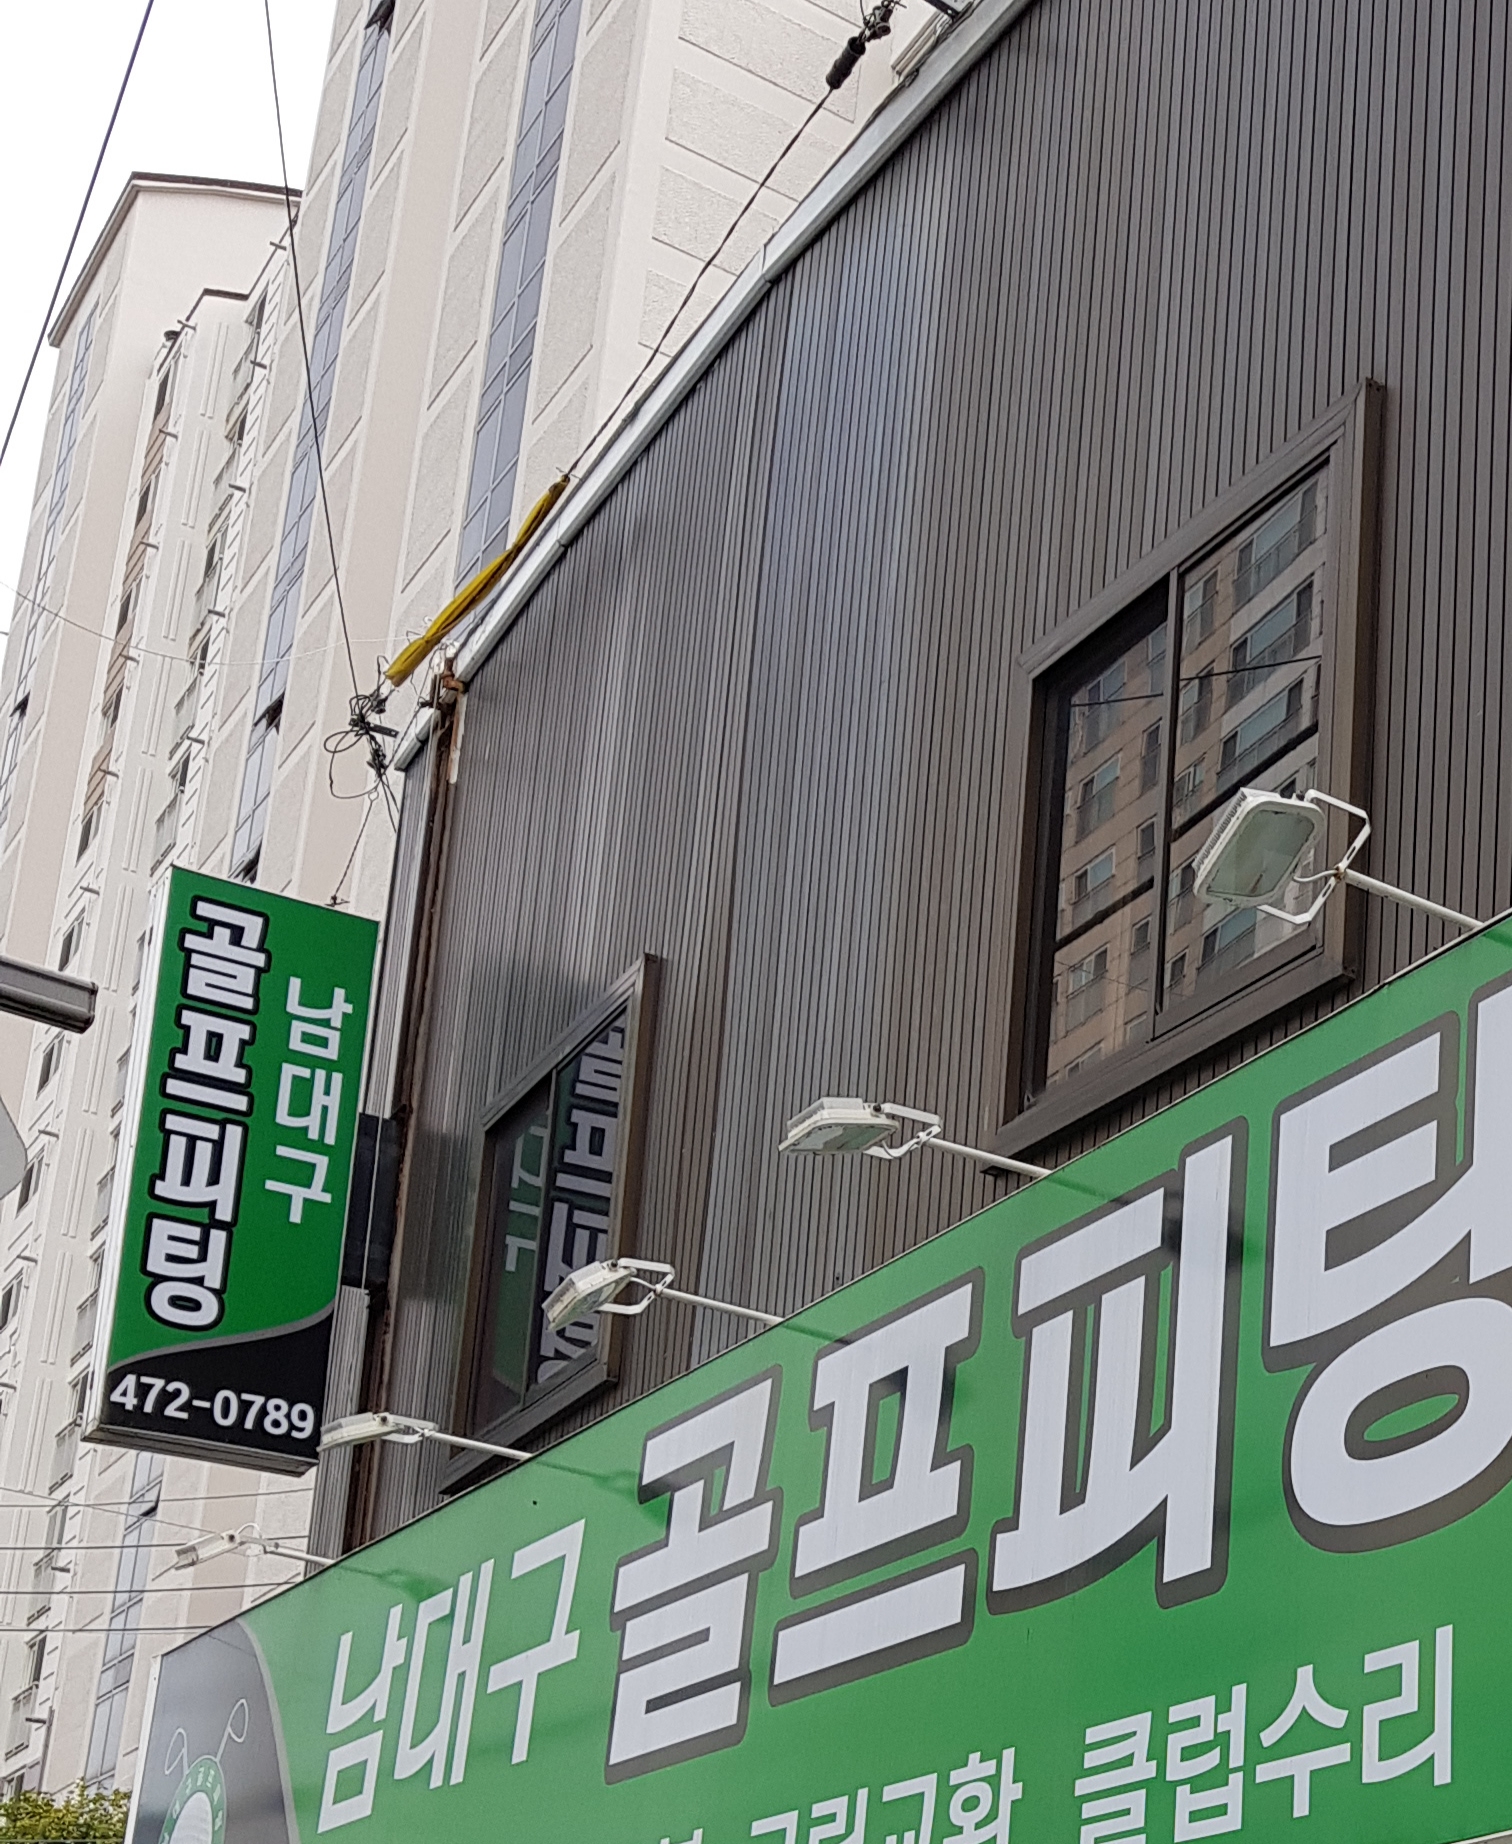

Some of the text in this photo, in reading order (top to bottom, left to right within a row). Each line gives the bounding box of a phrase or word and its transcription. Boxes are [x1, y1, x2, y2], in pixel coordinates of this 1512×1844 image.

[145, 898, 268, 1329] 골프피팅
[265, 976, 353, 1224] 남대구
[110, 1373, 315, 1440] 472-0789
[317, 1518, 586, 1834] 남대구
